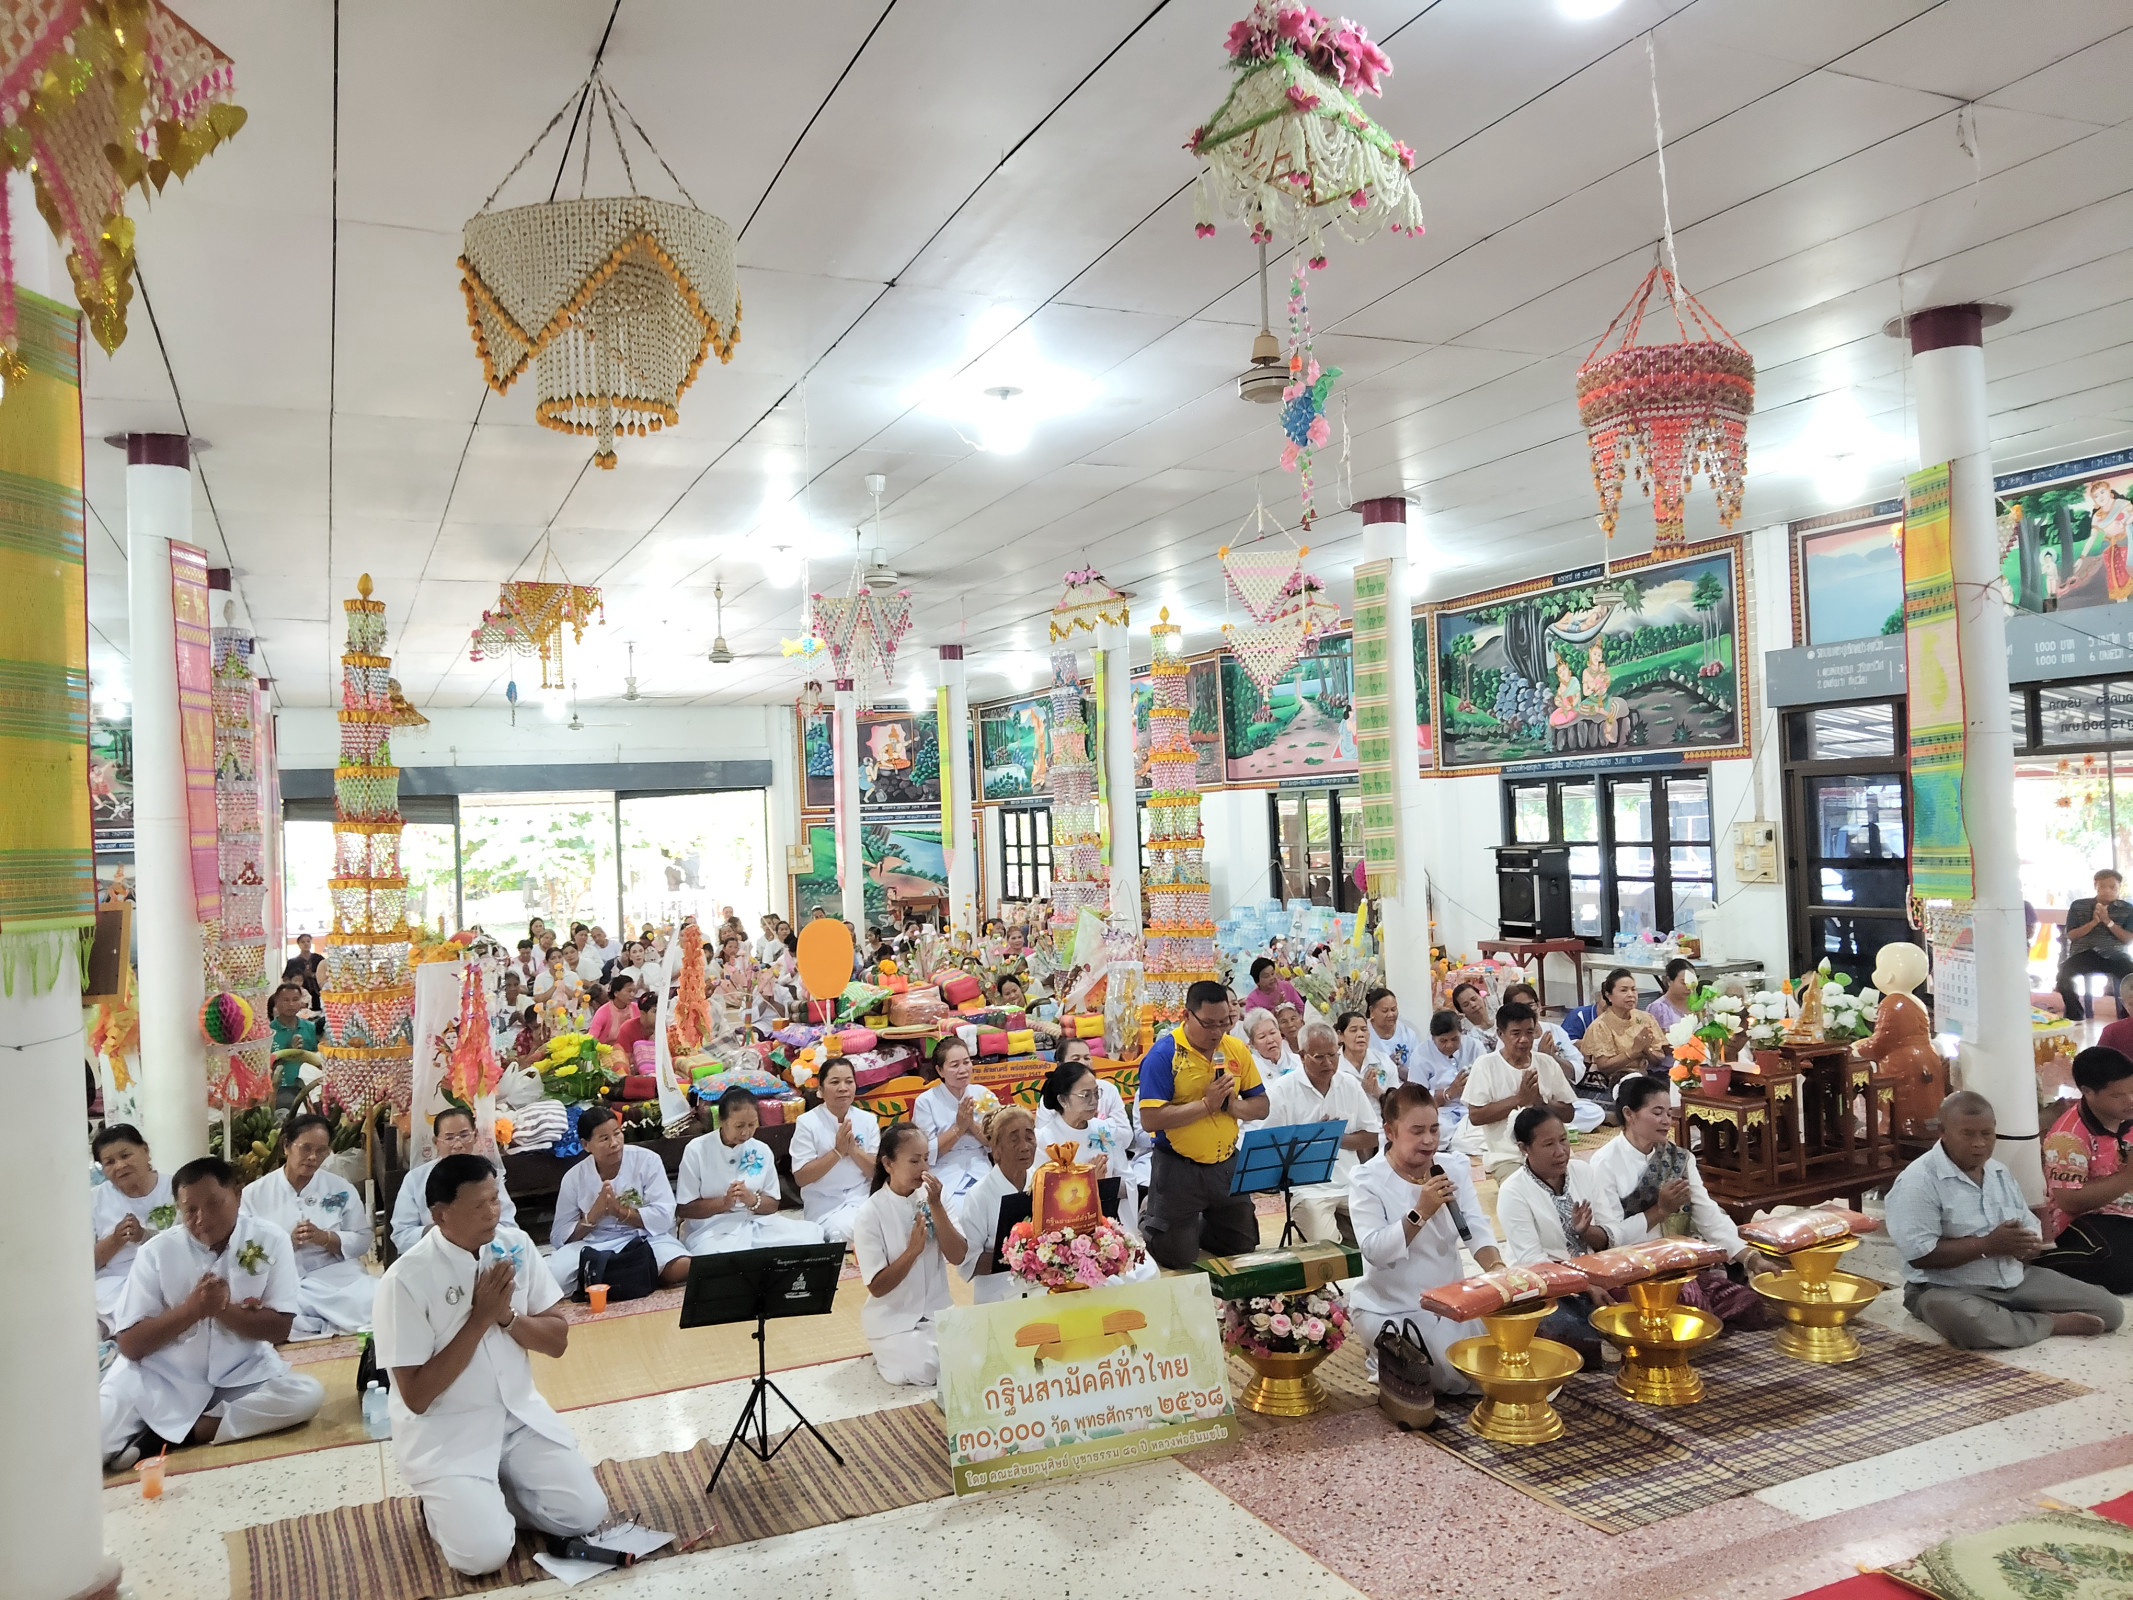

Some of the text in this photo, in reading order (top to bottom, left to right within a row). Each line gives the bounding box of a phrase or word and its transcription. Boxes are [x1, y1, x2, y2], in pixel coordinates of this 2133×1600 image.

[984, 1350, 1189, 1416] กฐินสามัคคีทั่วไทย
[958, 1386, 1224, 1452] ๓๐,๐๐๐ วัด พุทธศักราช ๒๕๖๘
[965, 1471, 987, 1488] โดย
[989, 1452, 1069, 1483] คณะศิษยานุศิษย์
[1072, 1447, 1120, 1470] บูชาธรรม
[1139, 1438, 1149, 1455] ปี
[1150, 1426, 1229, 1451] หลวงพ่อธัมมชโย
